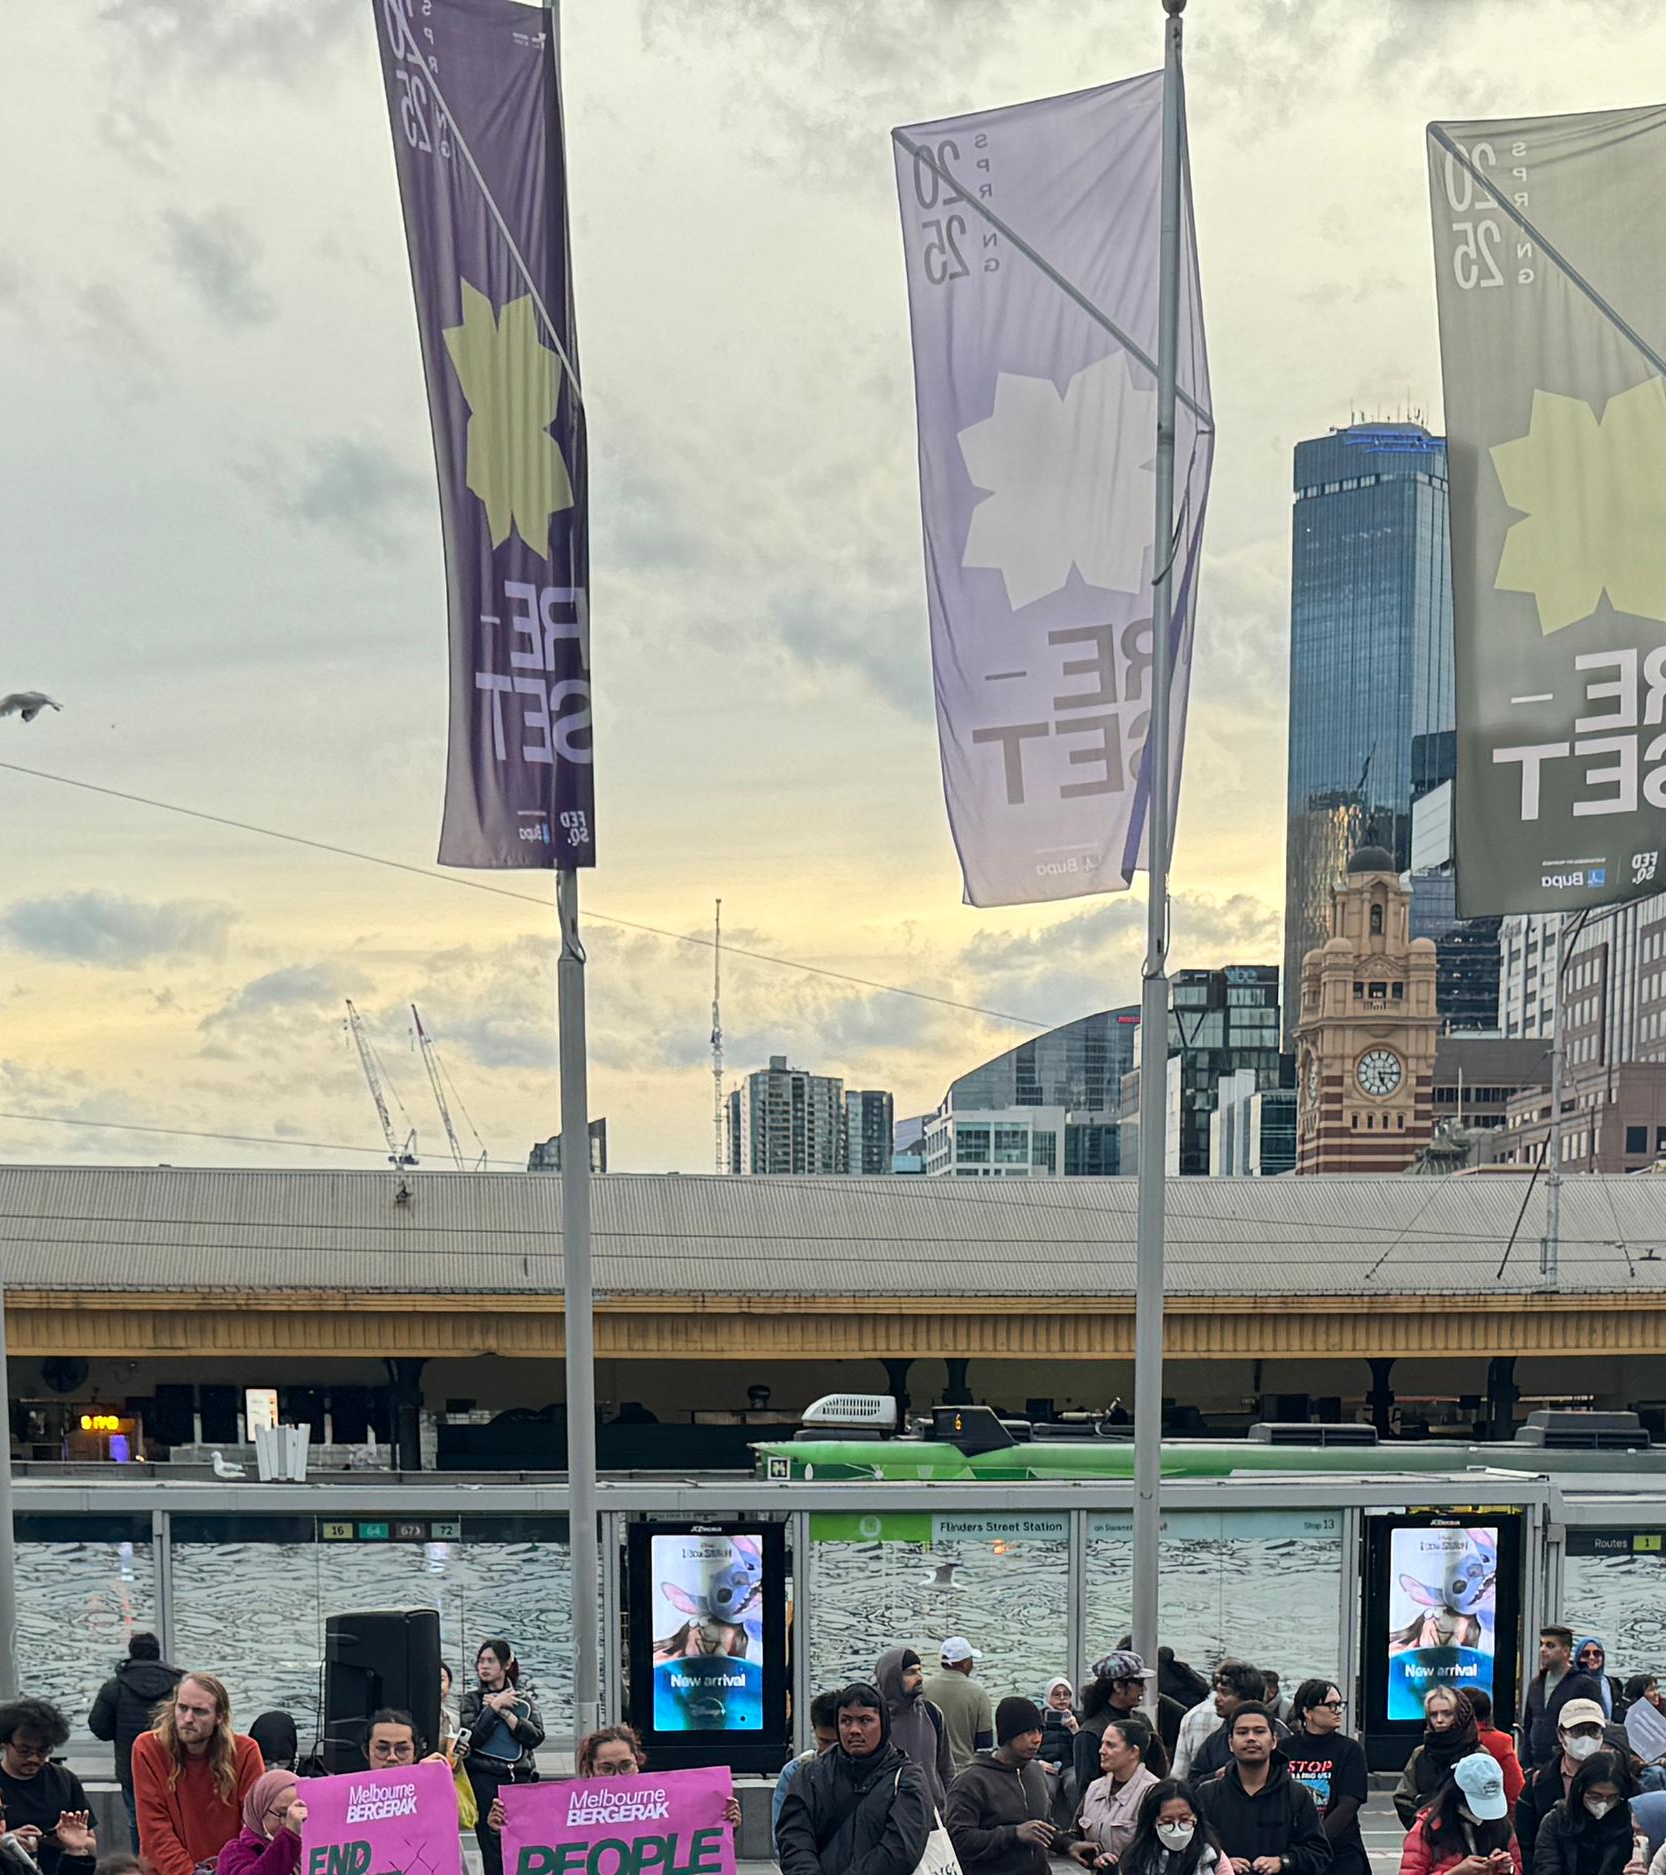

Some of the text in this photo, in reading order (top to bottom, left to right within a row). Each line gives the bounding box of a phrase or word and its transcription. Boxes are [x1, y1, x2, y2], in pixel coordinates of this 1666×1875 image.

[331, 1525, 345, 1535] 16
[440, 1525, 453, 1535] 72
[940, 1522, 1062, 1533] Flinders Street Station
[1323, 1519, 1335, 1530] 13
[1594, 1538, 1628, 1549] Routes
[1436, 1663, 1478, 1677] arrival
[703, 1673, 746, 1687] arrival
[1288, 1760, 1333, 1772] STOP
[349, 1783, 416, 1805] Melbourne
[569, 1788, 666, 1810] Melbourne
[346, 1796, 418, 1824] BERGERAK
[566, 1802, 669, 1827] BERGERAK
